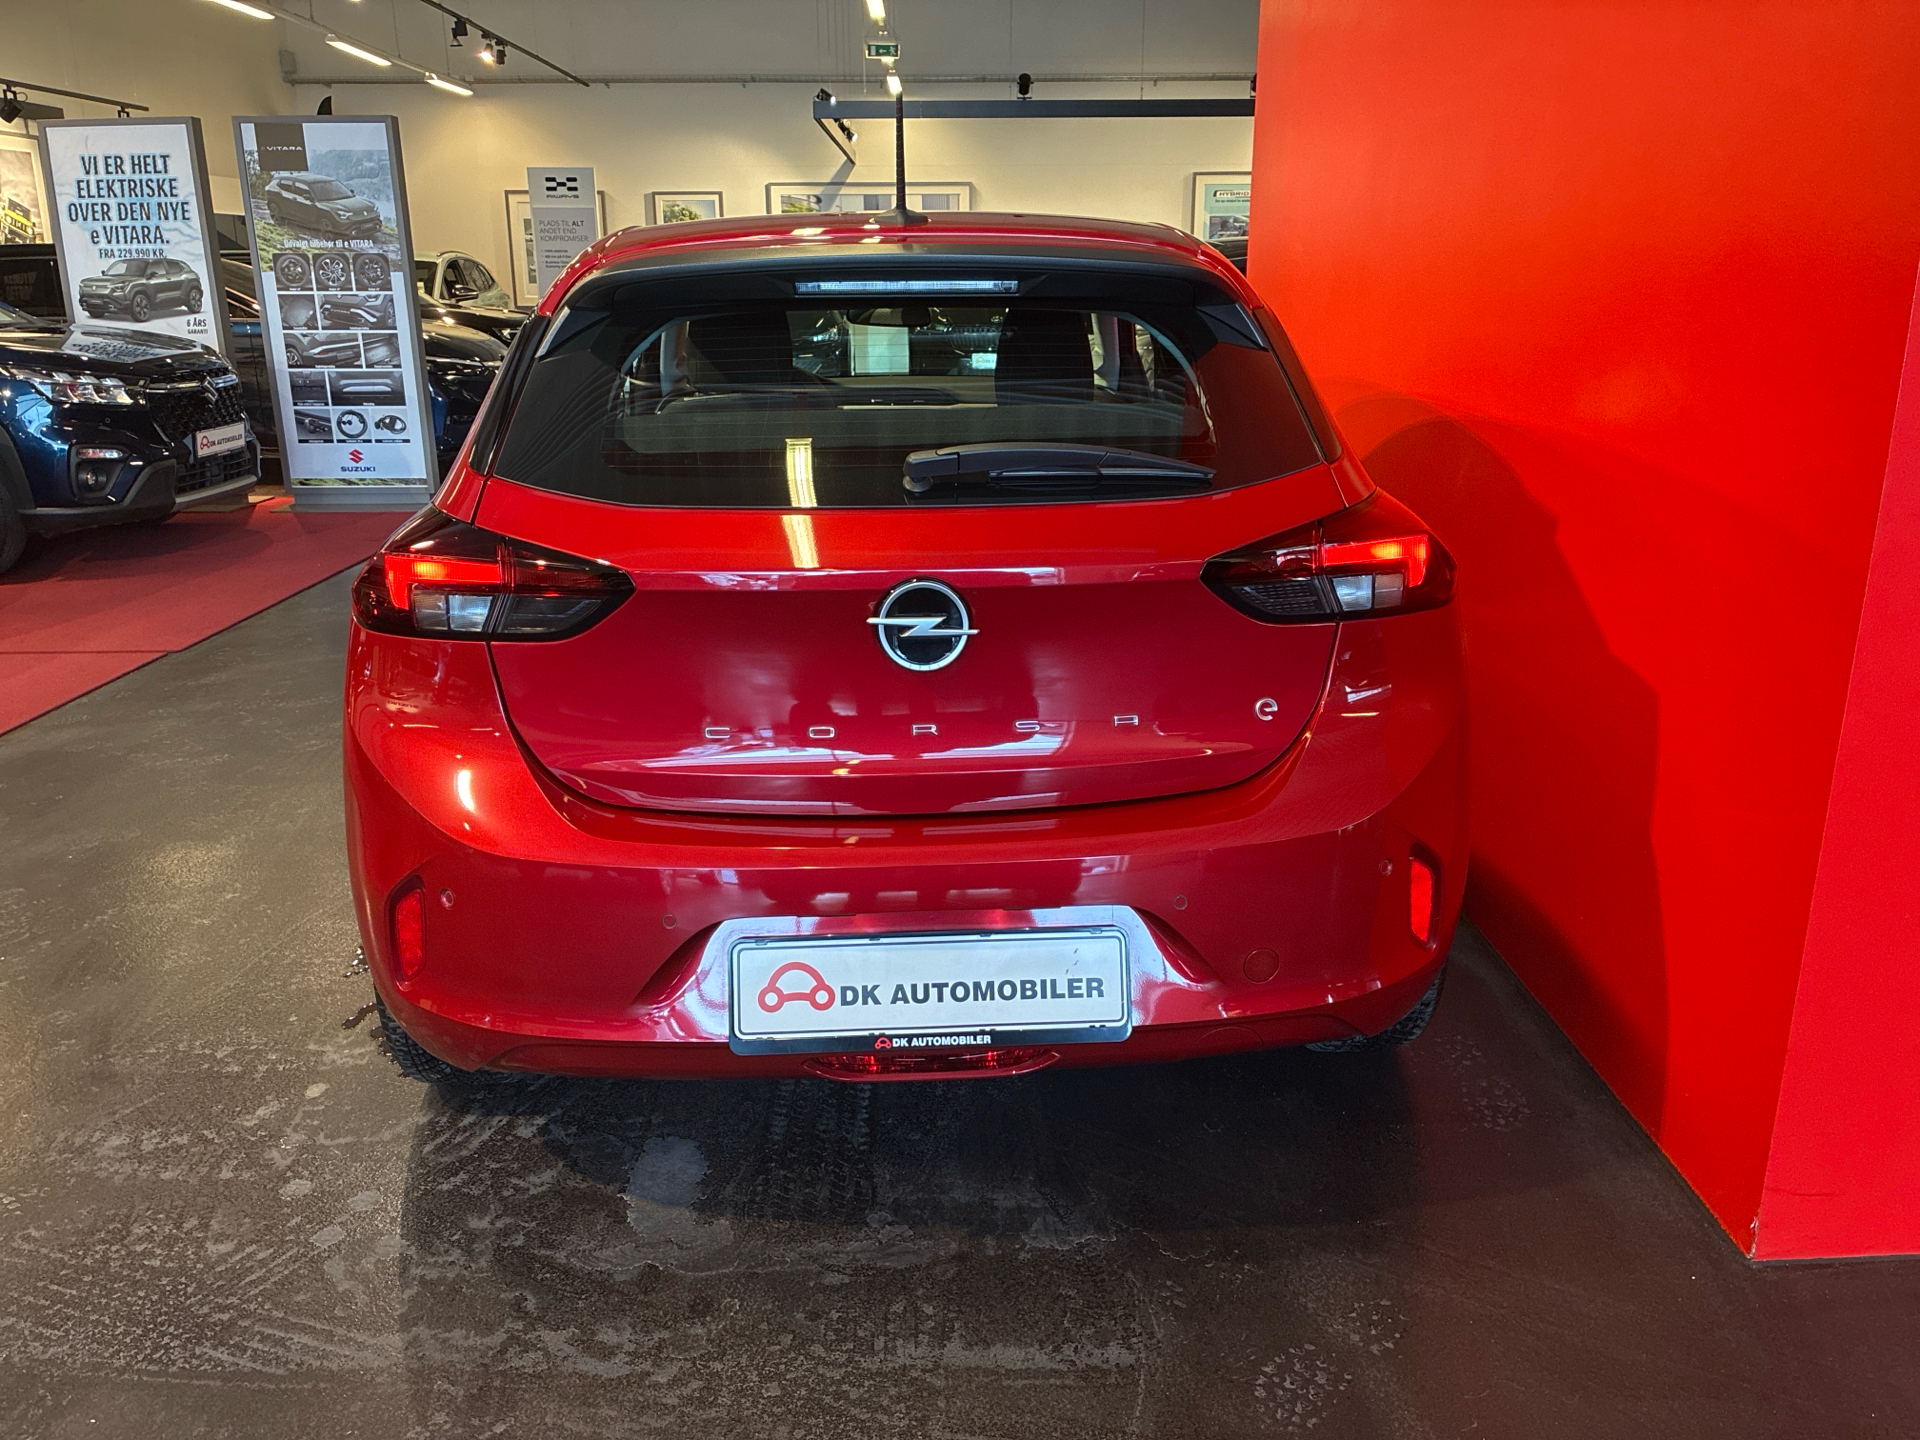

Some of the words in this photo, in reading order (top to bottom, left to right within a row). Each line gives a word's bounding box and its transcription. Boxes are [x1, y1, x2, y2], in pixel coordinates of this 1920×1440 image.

[80, 155, 98, 175] VI
[105, 155, 125, 175] ER
[131, 154, 170, 174] HELT
[77, 178, 178, 199] ELEKTRISKE
[68, 202, 112, 222] OVER
[117, 202, 151, 221] DEN
[157, 201, 190, 221] NYE
[91, 229, 99, 245] e
[103, 225, 170, 245] VITARA.
[284, 239, 309, 248] Udvalgt
[335, 240, 343, 248] til
[349, 239, 374, 248] VITARA
[99, 249, 115, 259] FRA
[118, 248, 150, 259] 229.990
[152, 248, 167, 259] KR.
[186, 319, 191, 328] 6
[192, 316, 207, 328] ÅRS
[704, 714, 1139, 739] CORSA
[840, 984, 882, 1007] DK
[890, 977, 1105, 1004] AUTOMOBILER
[892, 1037, 910, 1048] DK
[911, 1034, 992, 1047] AUTOMOBILER
